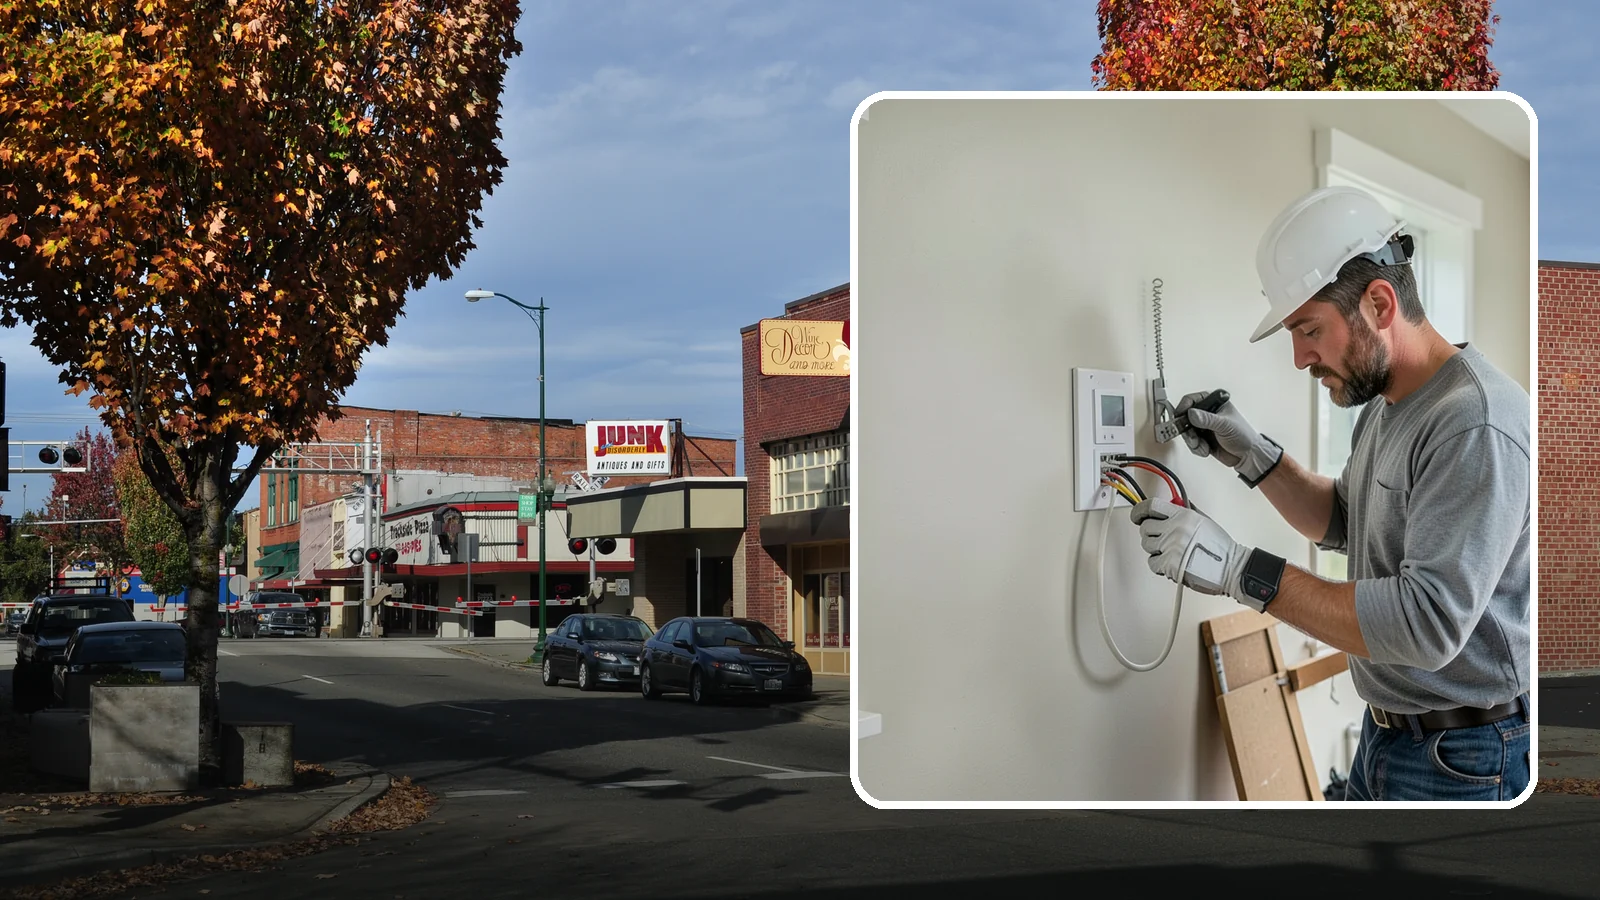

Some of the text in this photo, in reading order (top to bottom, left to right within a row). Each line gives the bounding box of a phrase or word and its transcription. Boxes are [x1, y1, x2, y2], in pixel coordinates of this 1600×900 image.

[595, 425, 665, 457] JUNK
[608, 446, 645, 454] DISORDERLY
[597, 460, 665, 470] ANTIQUES AND GIFTS
[414, 519, 429, 534] Pizza
